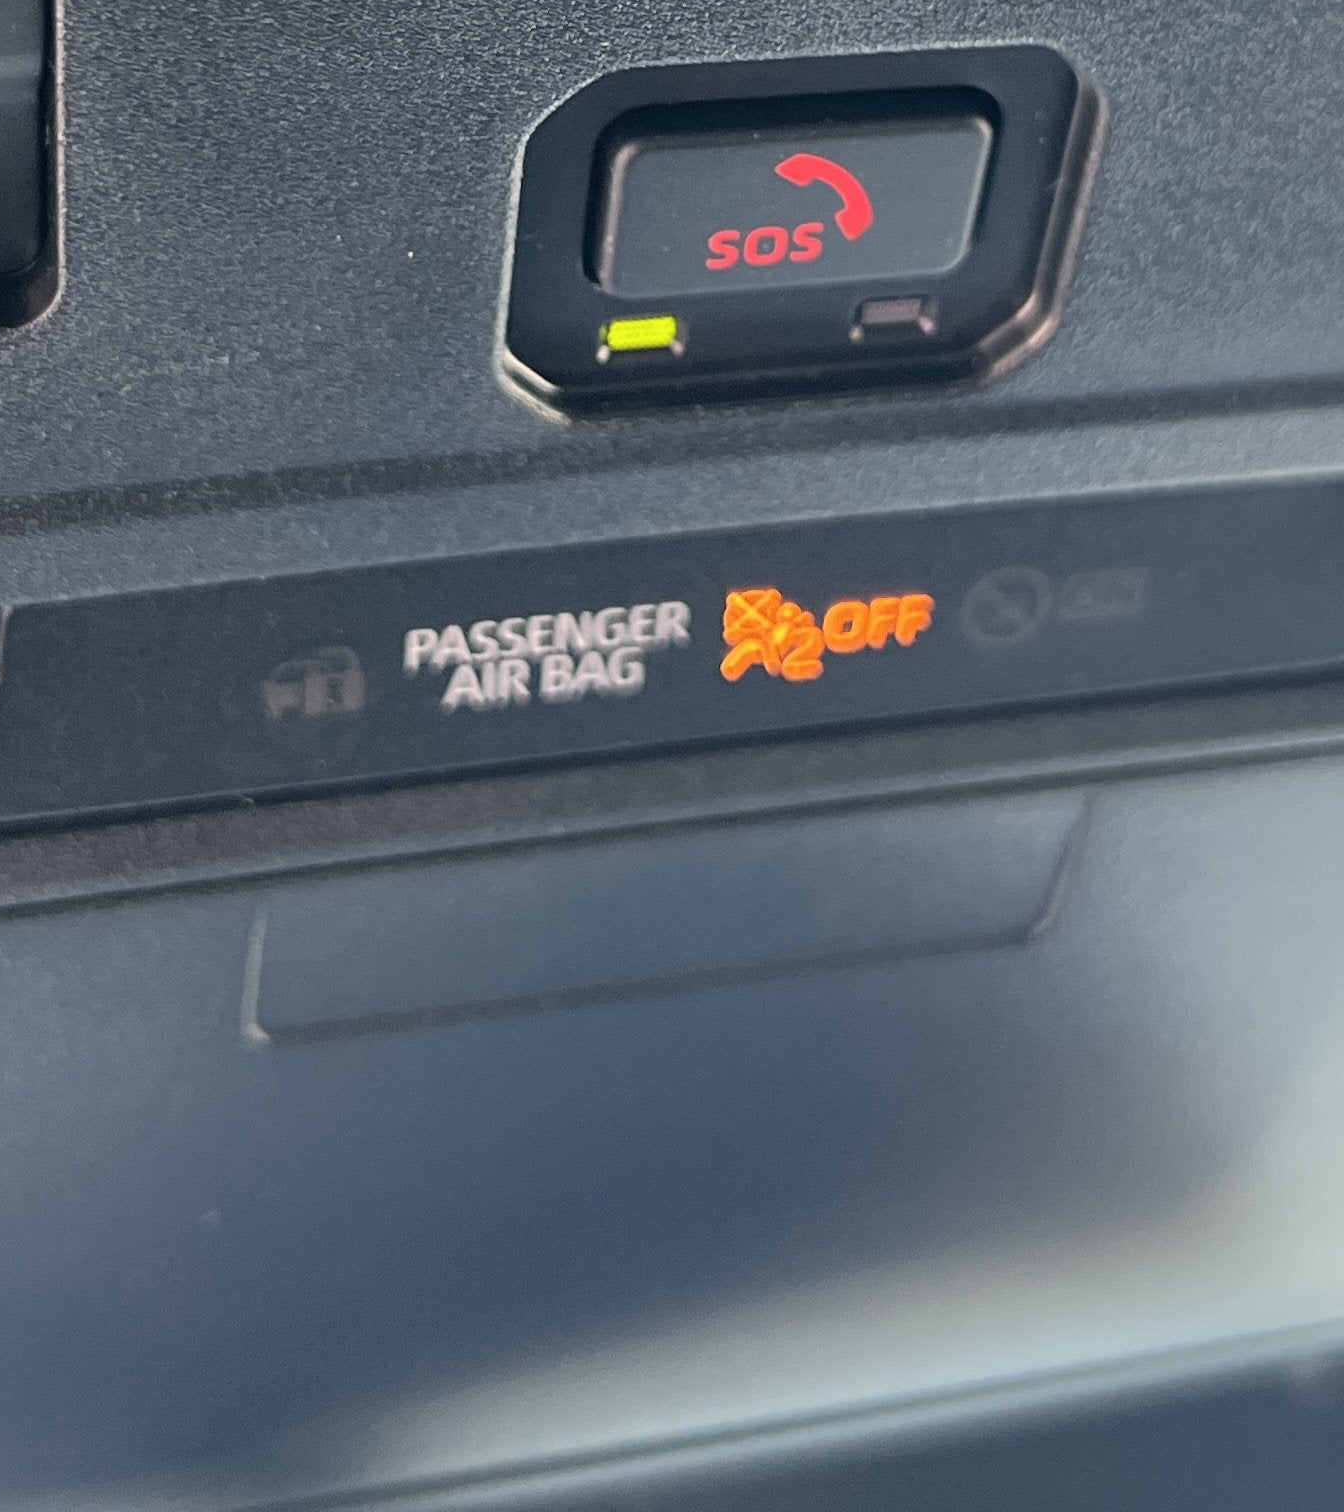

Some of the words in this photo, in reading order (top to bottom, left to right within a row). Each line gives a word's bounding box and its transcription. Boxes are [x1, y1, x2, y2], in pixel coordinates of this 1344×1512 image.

[704, 220, 824, 270] SOS
[404, 600, 692, 675] PASSENGER
[822, 593, 936, 653] OFF
[440, 659, 532, 713] AIR
[539, 645, 646, 702] BAG
